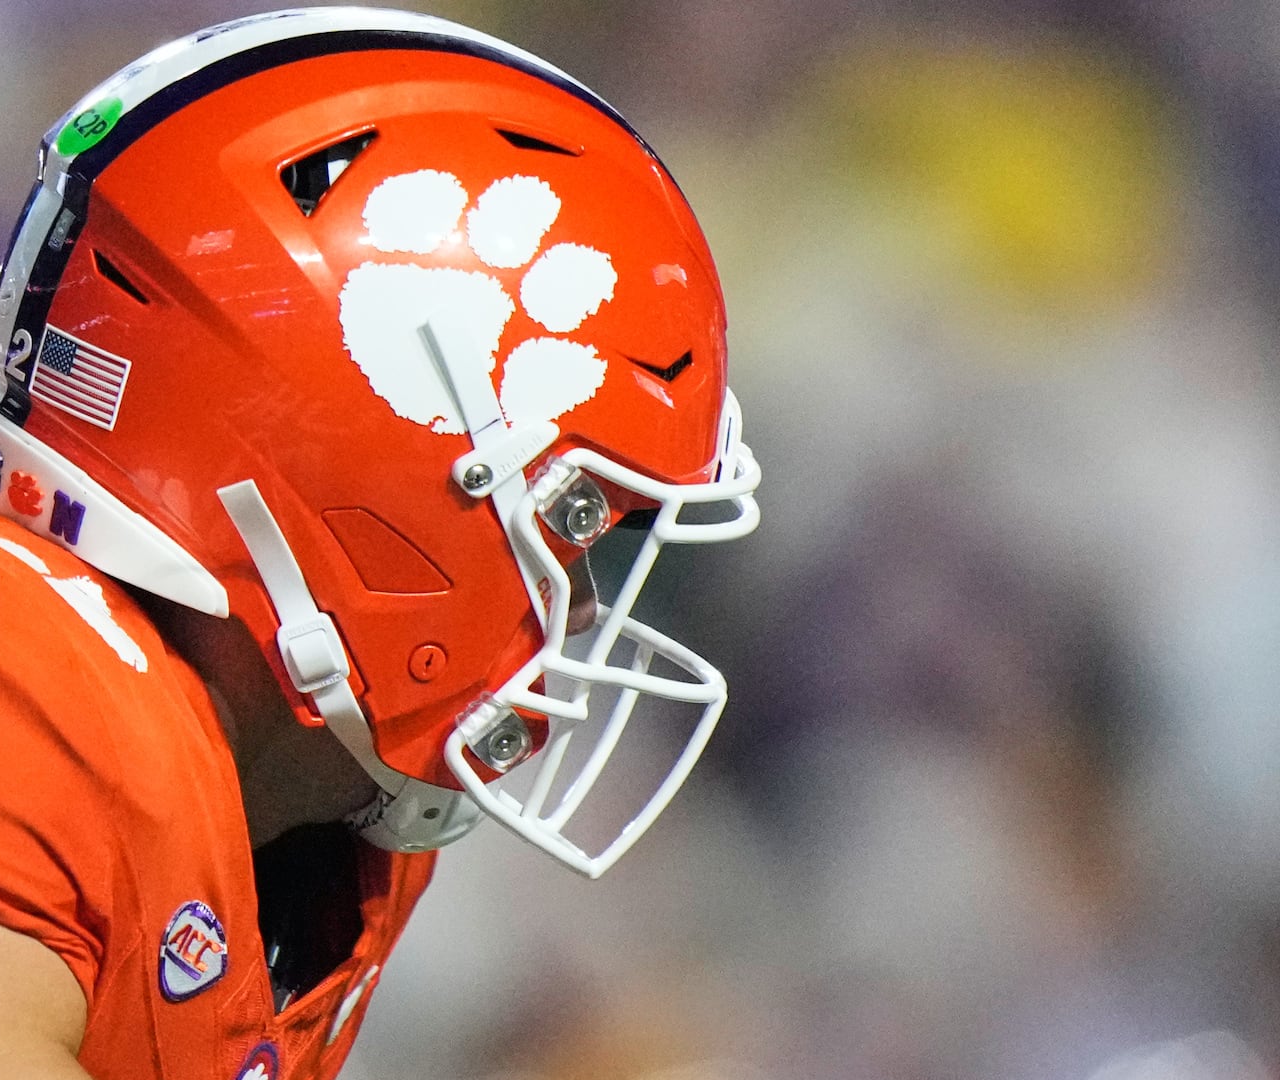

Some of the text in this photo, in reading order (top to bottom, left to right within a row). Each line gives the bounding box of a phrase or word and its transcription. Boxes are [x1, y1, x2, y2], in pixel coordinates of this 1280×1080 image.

[73, 109, 108, 139] C2P
[6, 328, 33, 383] 2
[168, 923, 223, 973] ACC
